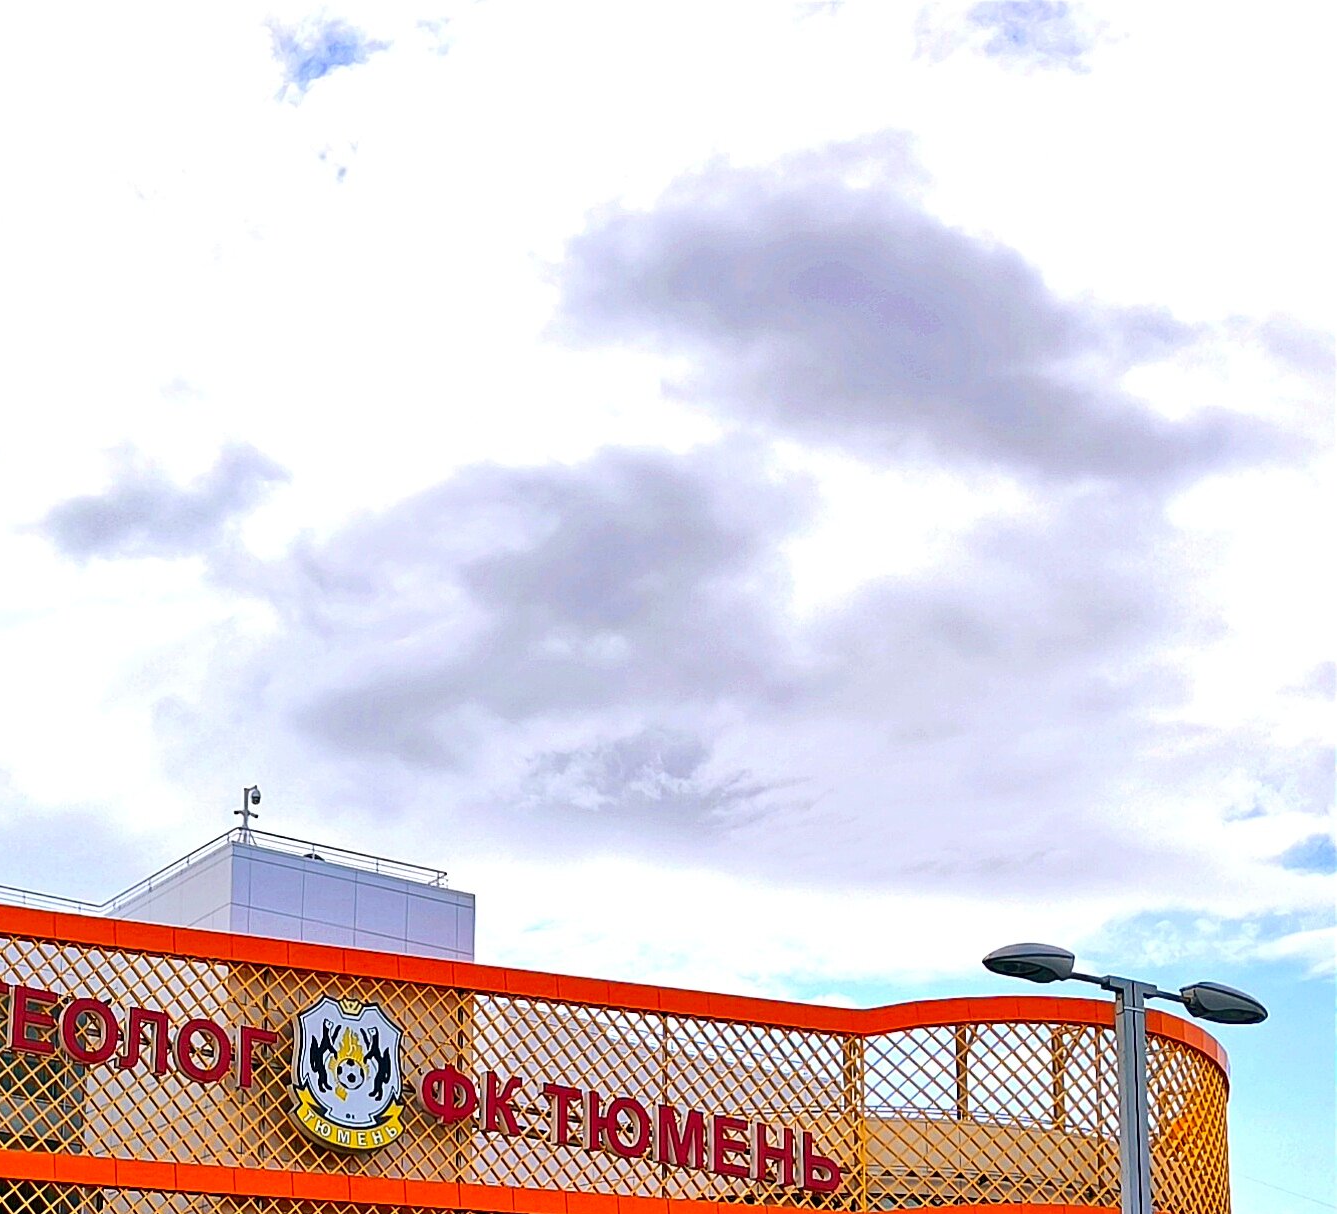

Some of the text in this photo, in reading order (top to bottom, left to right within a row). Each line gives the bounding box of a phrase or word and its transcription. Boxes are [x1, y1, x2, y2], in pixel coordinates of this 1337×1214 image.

[303, 1109, 399, 1146] ТЮМЕНЬ
[420, 1064, 844, 1193] ФК ТЮМЕНЬ
